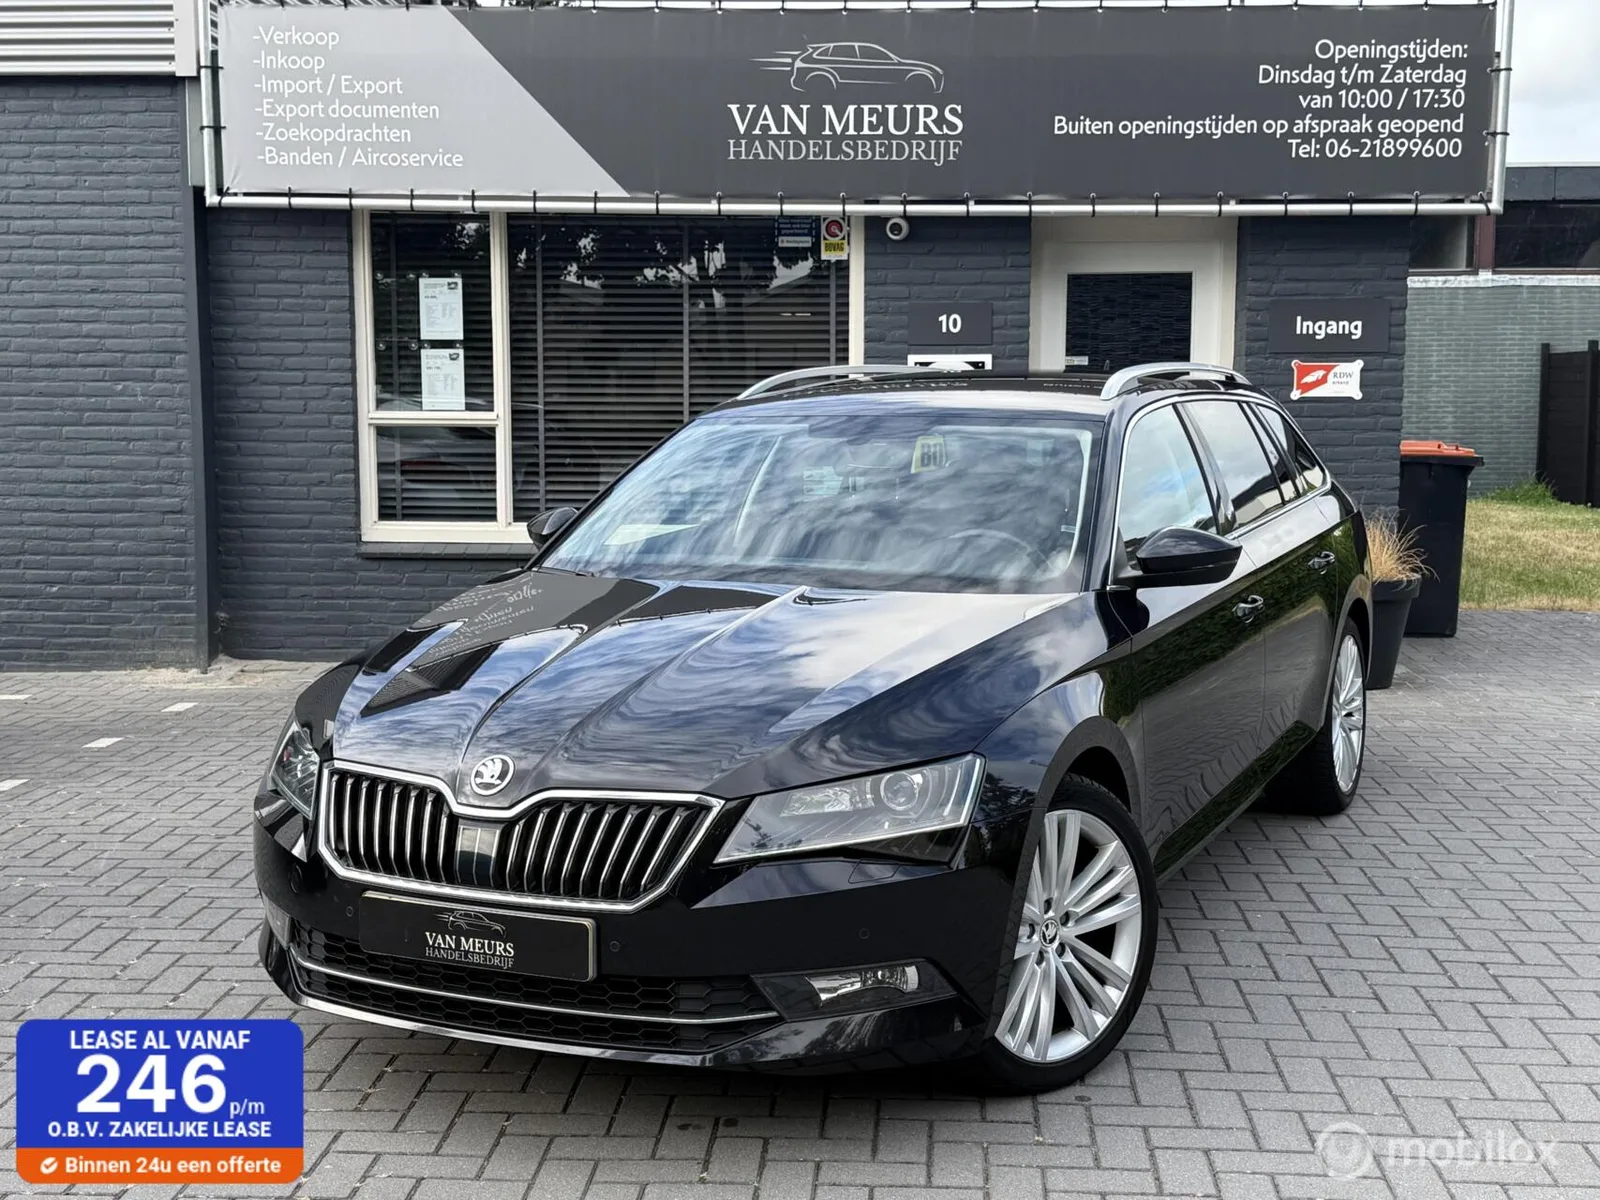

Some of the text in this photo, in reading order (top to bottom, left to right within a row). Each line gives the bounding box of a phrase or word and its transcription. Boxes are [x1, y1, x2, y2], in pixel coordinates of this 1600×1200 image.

[253, 26, 339, 49] -Verkoop
[253, 51, 325, 73] -Inkoop
[1315, 39, 1468, 62] Openingstijden:
[254, 74, 323, 97] -Import
[341, 75, 403, 97] Export
[1259, 65, 1466, 87] Dinsdag t/m Zaterdag
[255, 99, 440, 121] -Export documenten
[1299, 92, 1332, 109] van
[1338, 89, 1393, 109] 10:00
[1413, 90, 1465, 108] 17:30
[727, 104, 963, 135] VAN MEURS
[1054, 114, 1464, 139] Buiten openingstijden op afspraak geopend
[256, 123, 411, 146] -Zoekopdrachten
[257, 147, 332, 166] -Banden
[352, 148, 464, 167] Aircoservice
[727, 140, 962, 166] HANDELSBEDRIJF
[1287, 139, 1462, 158] Tel: 06-21899600
[938, 314, 962, 333] 10
[1296, 316, 1362, 339] Ingang
[1333, 371, 1353, 379] RDW
[424, 931, 514, 957] VAN MEURS
[425, 946, 515, 969] HANDELSBEDRIJF
